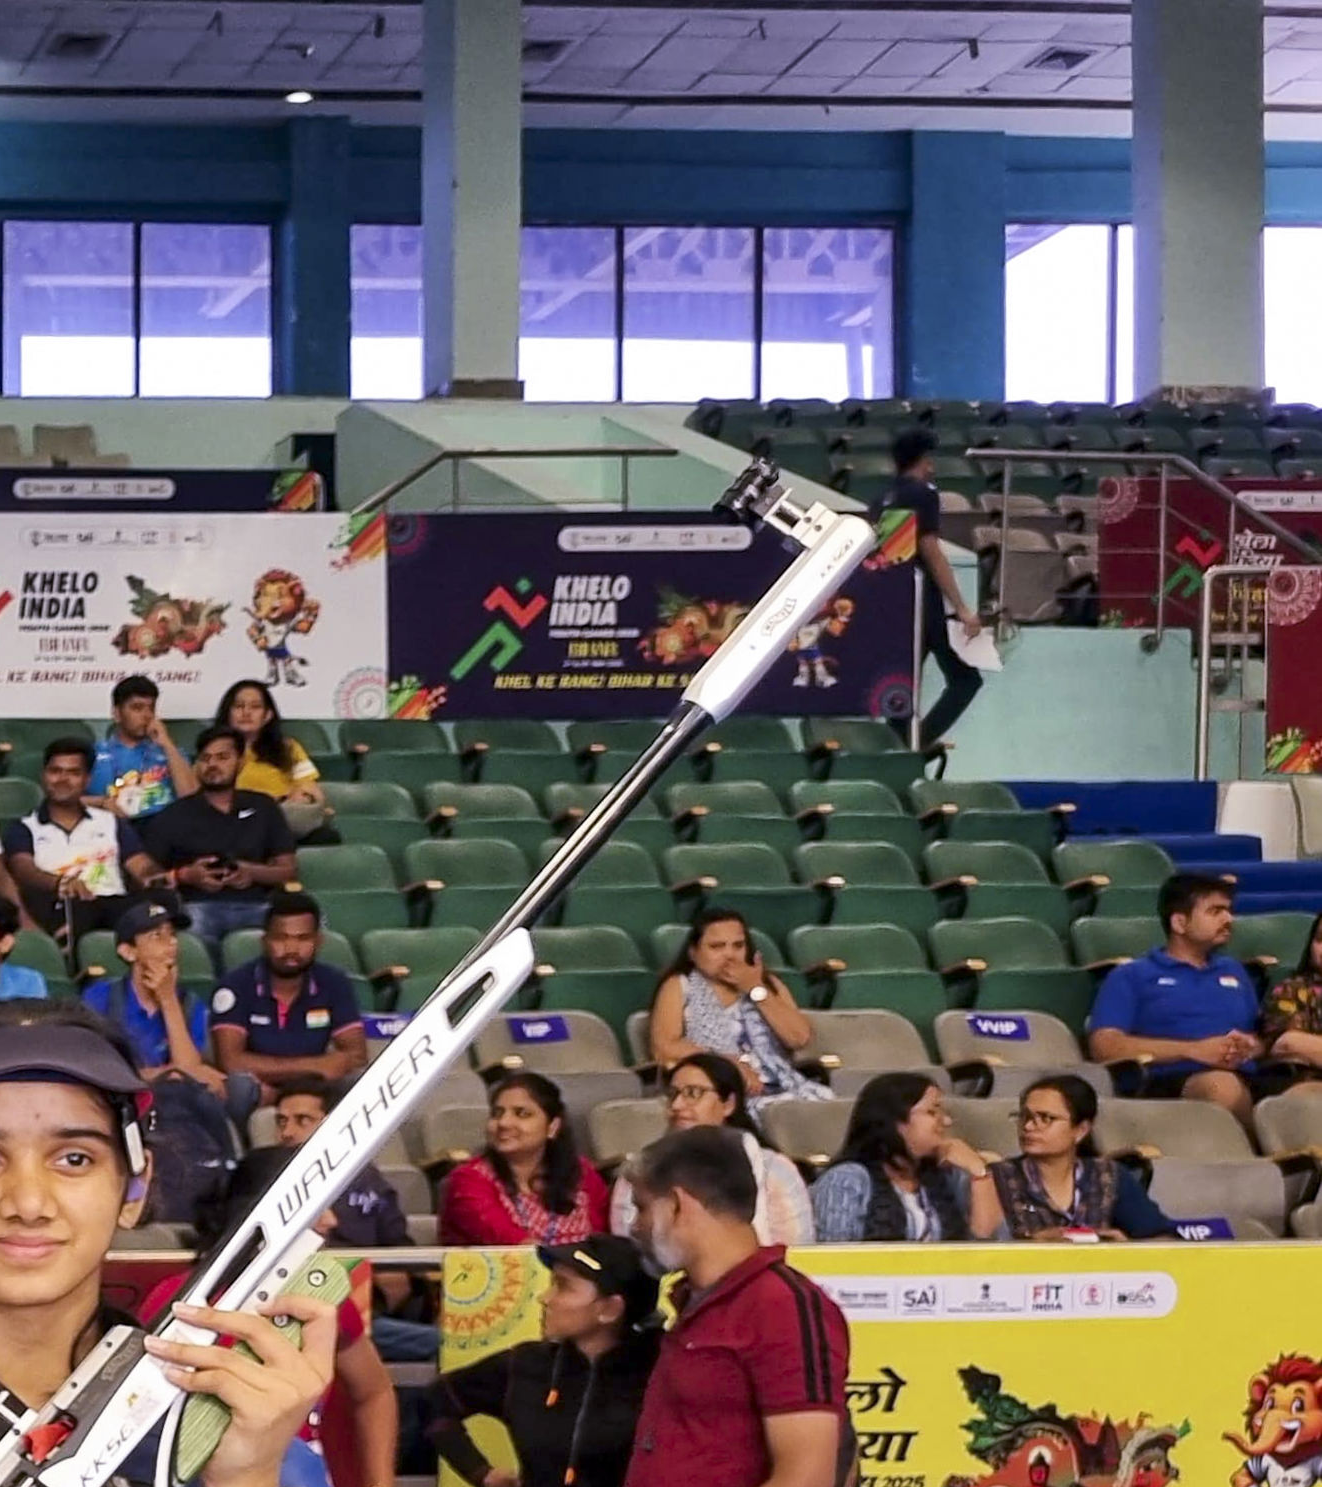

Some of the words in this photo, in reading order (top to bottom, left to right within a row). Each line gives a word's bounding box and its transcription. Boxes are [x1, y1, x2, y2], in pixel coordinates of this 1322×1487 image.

[22, 570, 100, 594] KHELO
[553, 575, 632, 601] KHELO
[18, 596, 86, 621] INDIA
[548, 600, 618, 627] INDIA
[277, 1034, 436, 1226] WALTHER
[902, 1285, 937, 1308] SAI
[1032, 1282, 1063, 1301] FIT
